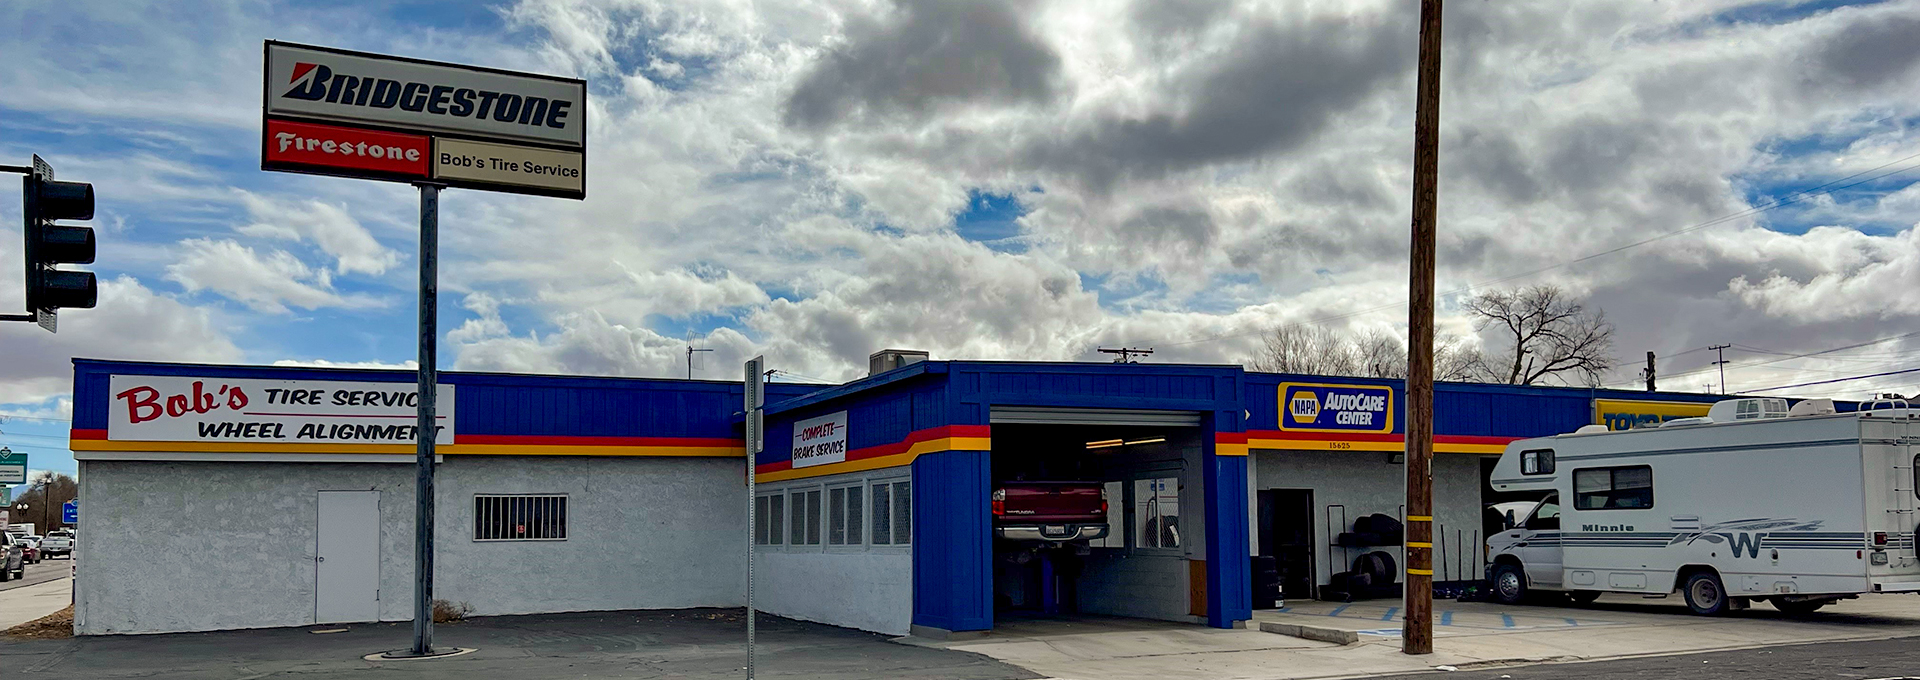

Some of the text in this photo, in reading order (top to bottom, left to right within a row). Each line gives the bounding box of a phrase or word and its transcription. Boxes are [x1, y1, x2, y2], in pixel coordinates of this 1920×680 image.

[281, 62, 572, 129] BRIDGESTONE
[275, 132, 421, 162] Firestone
[440, 153, 579, 179] Bob's Tire Service
[116, 381, 418, 424] Bob's TIRE SERVIC
[1294, 399, 1316, 415] NAPA
[1336, 411, 1373, 425] CENTER
[197, 421, 286, 439] WHEEL
[802, 422, 835, 442] COMPLETE
[793, 439, 845, 460] BRAKE SERVICE
[1582, 524, 1634, 532] Minnie
